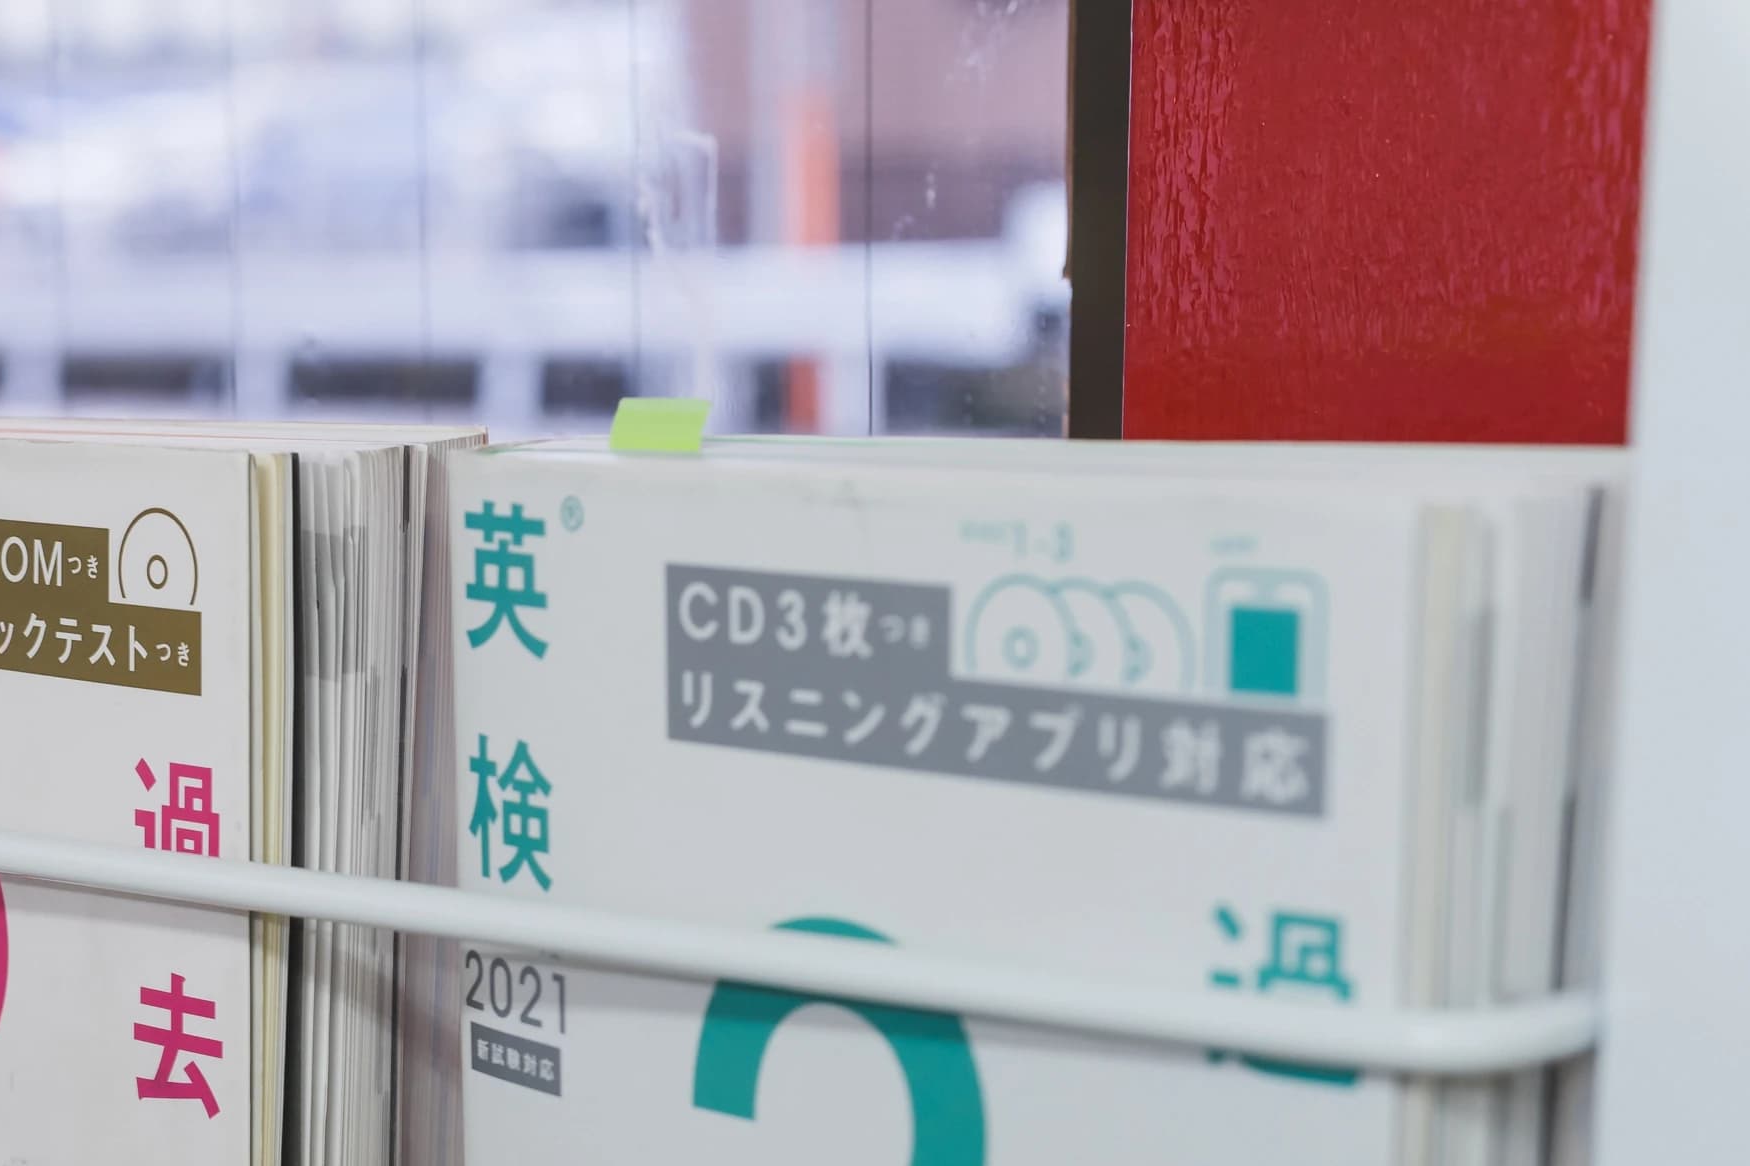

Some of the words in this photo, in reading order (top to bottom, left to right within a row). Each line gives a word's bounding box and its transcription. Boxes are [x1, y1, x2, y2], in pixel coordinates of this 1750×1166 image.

[677, 580, 932, 659] CD3枚つき
[463, 500, 553, 892] 英検
[679, 671, 1313, 801] リスニングアプリ対応
[465, 949, 567, 1035] 2021
